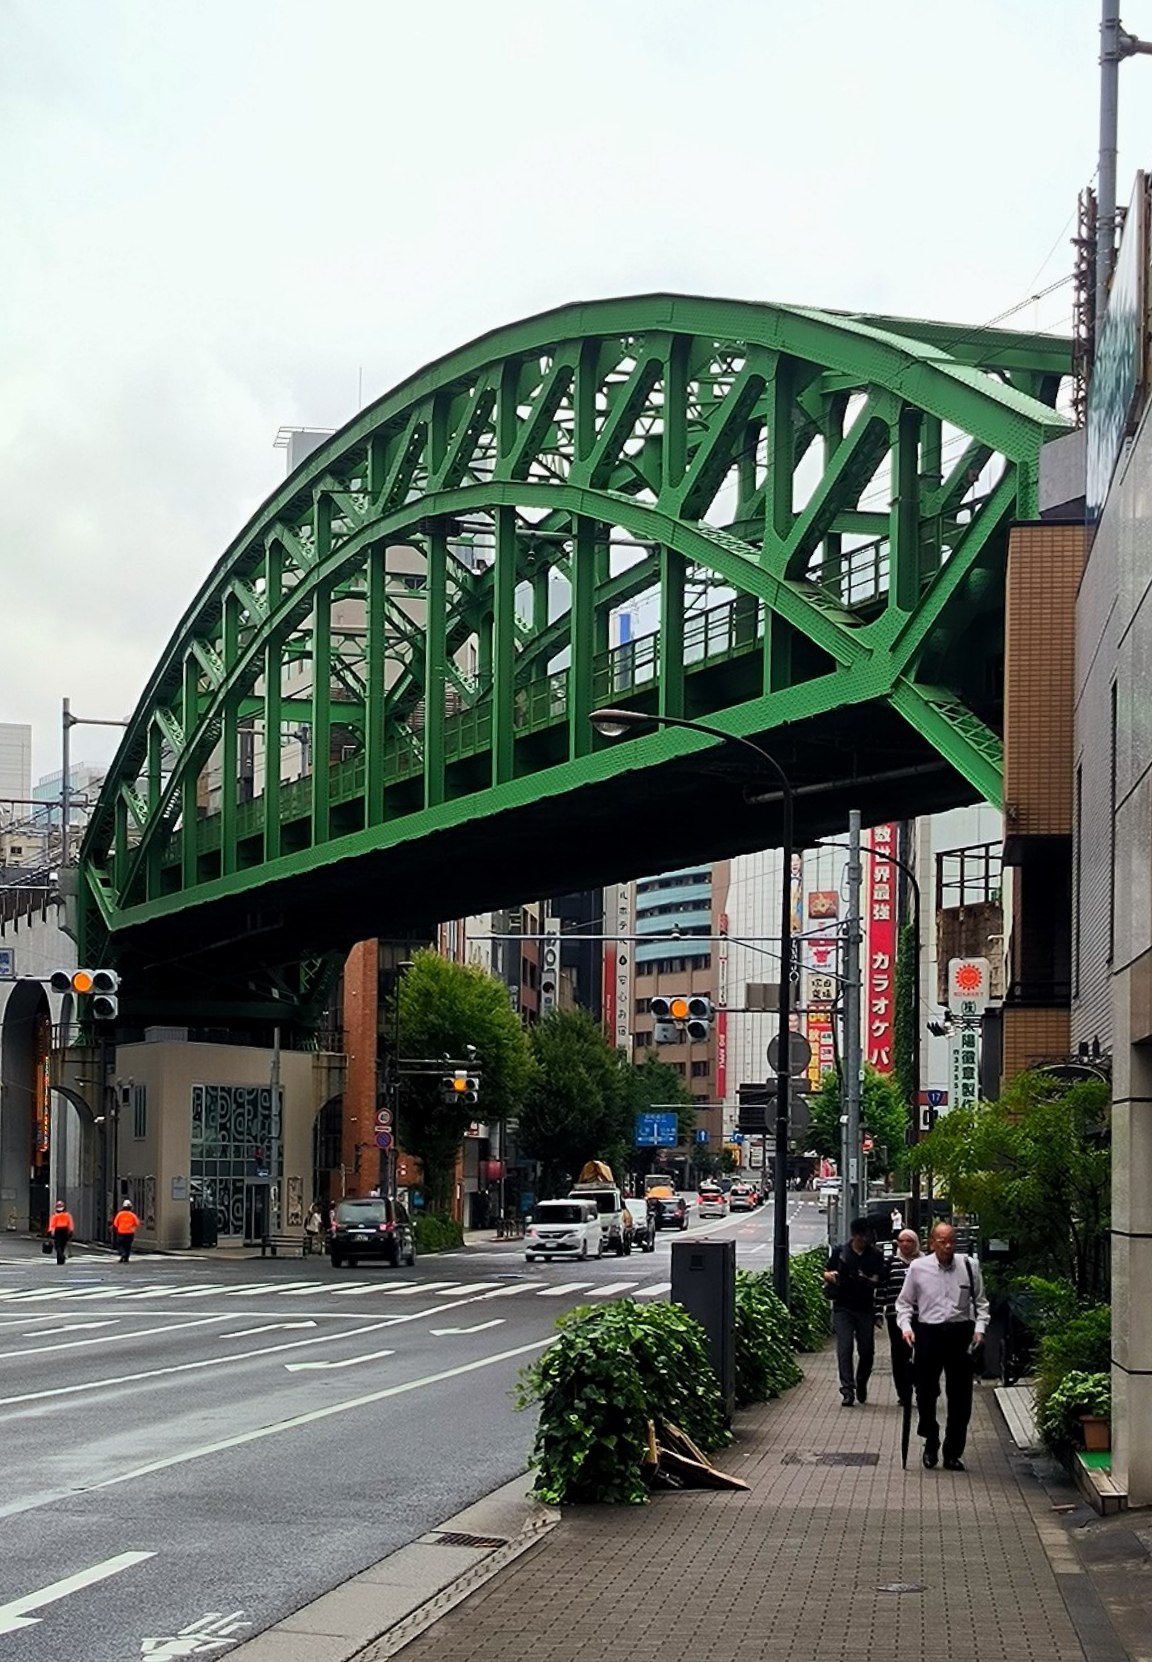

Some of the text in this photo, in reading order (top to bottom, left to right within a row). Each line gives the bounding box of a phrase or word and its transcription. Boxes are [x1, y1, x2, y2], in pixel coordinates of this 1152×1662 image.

[872, 951, 890, 1037] カラオケ
[931, 1093, 942, 1103] 17
